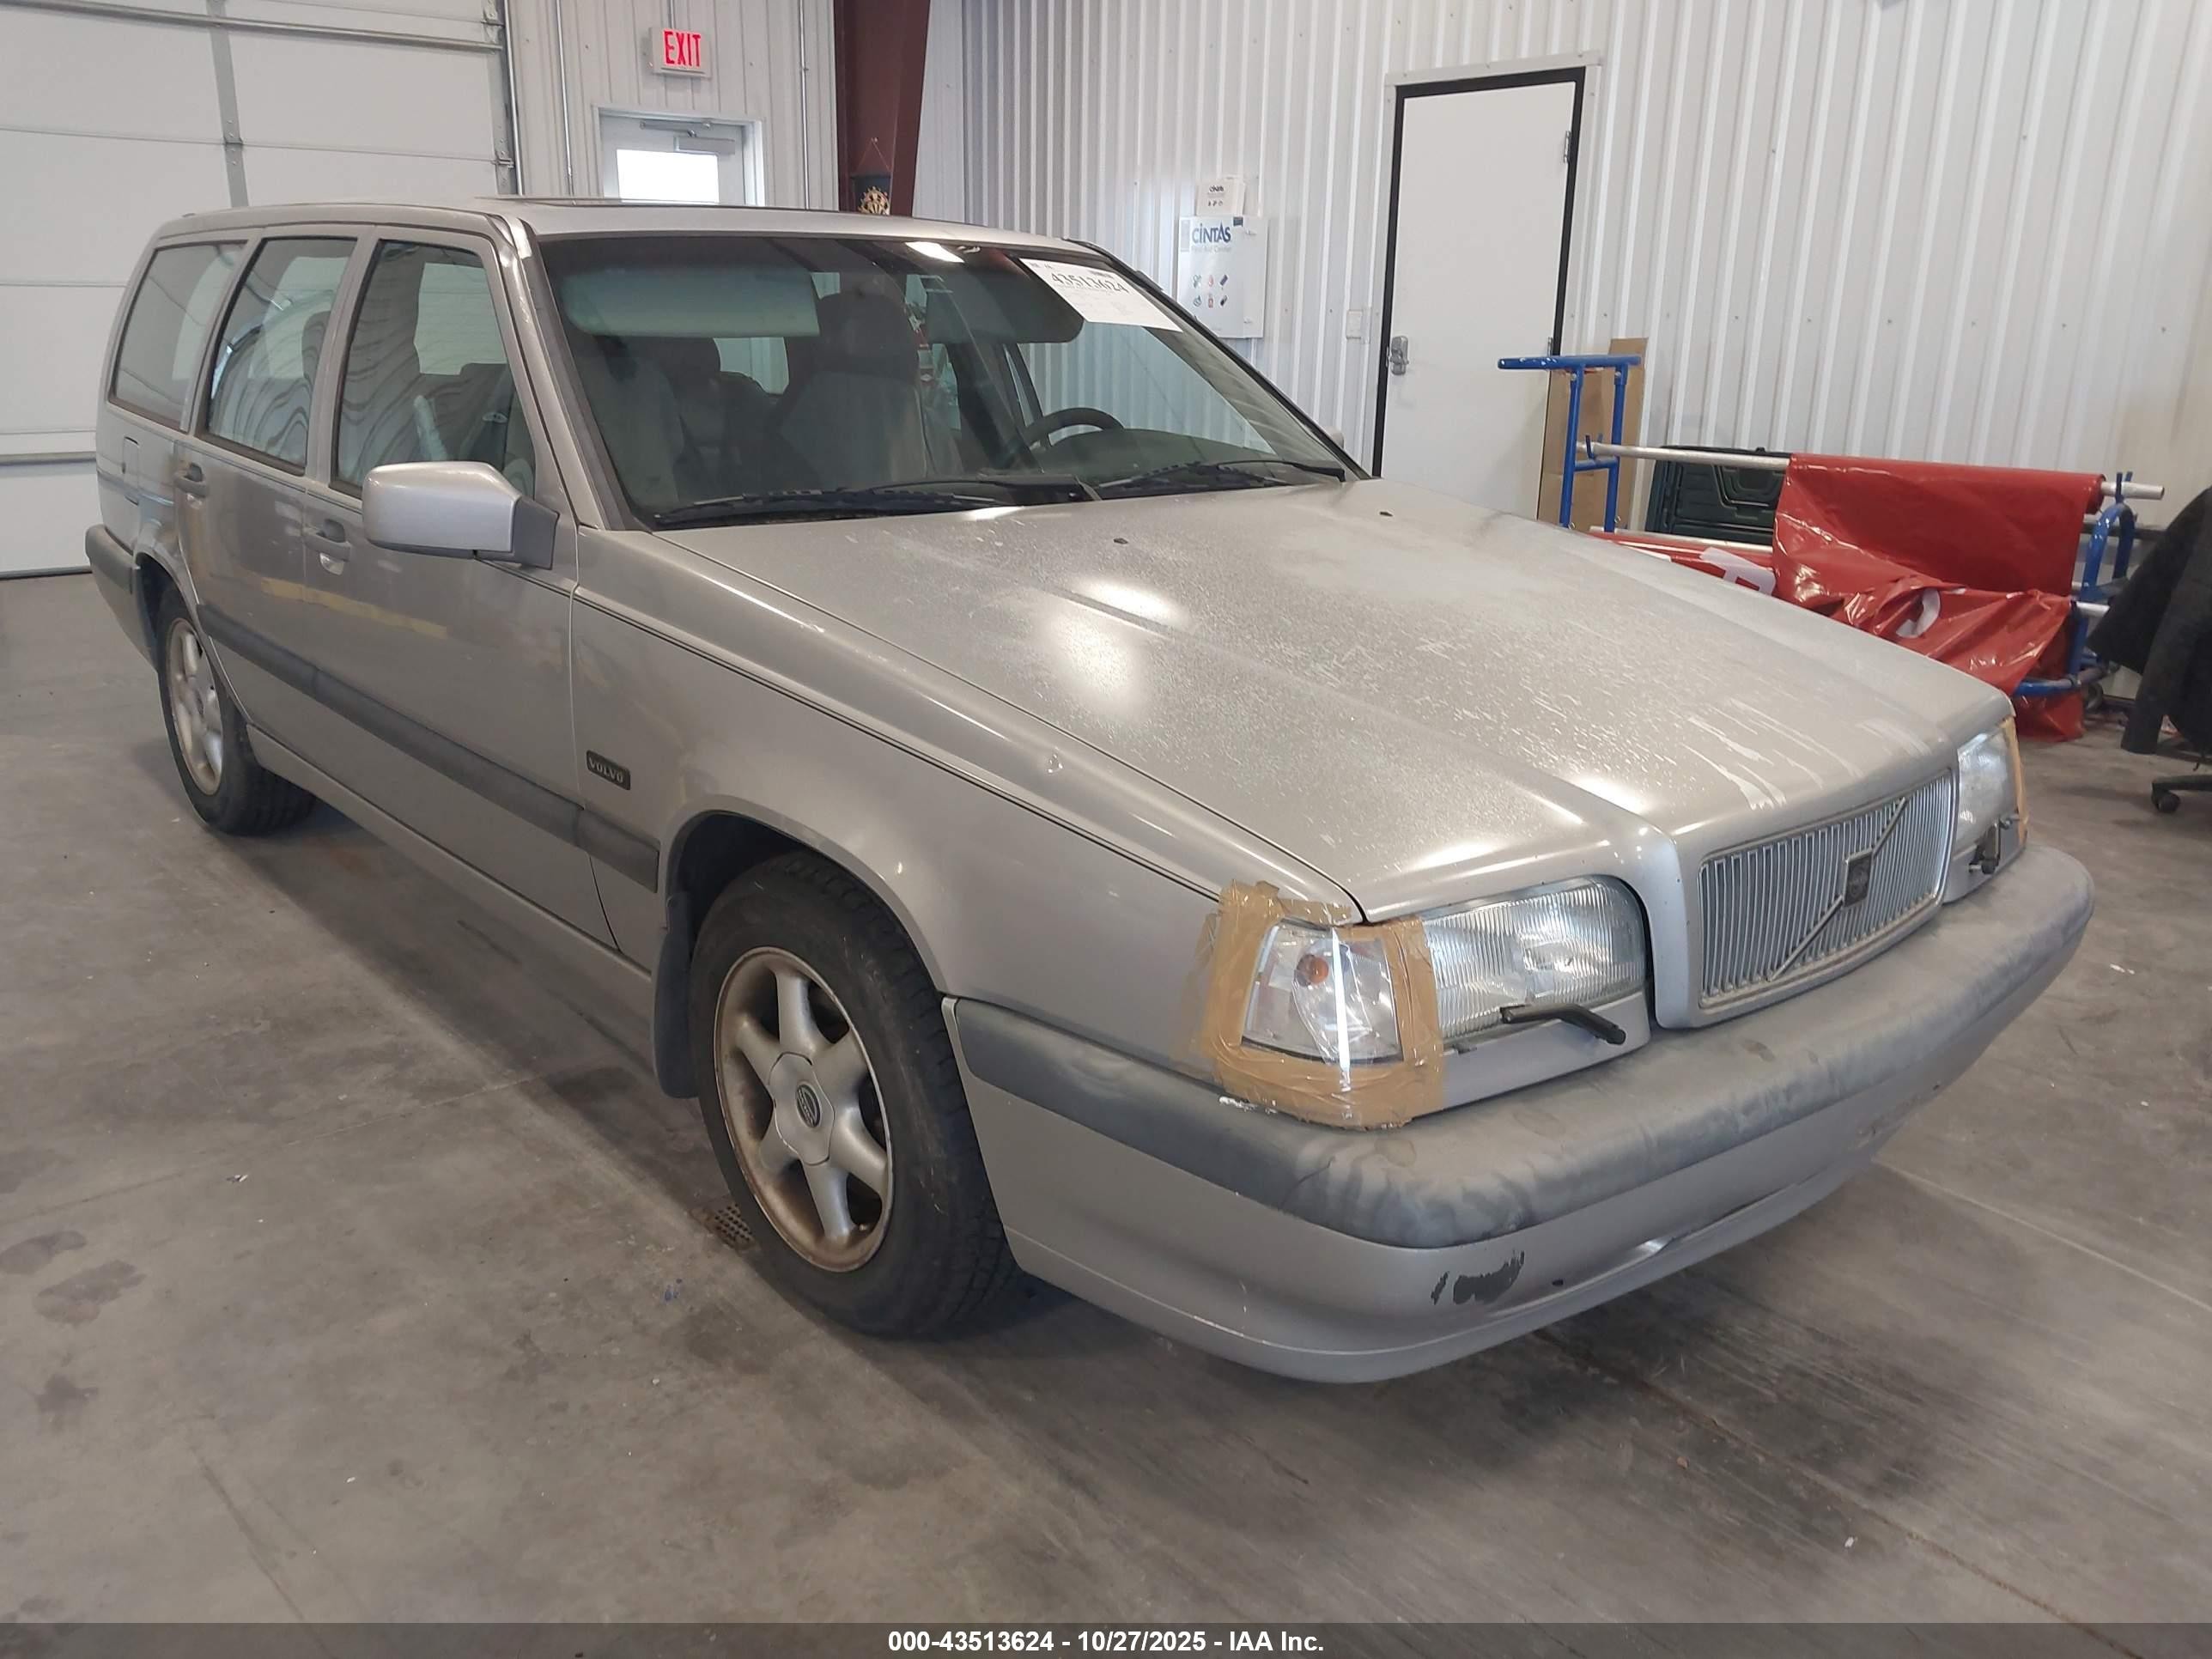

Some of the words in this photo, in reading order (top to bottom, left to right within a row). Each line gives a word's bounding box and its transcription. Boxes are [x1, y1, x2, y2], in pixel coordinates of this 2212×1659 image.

[663, 30, 702, 67] EXIT
[1050, 271, 1130, 294] 43513624
[588, 756, 624, 783] VOLVO
